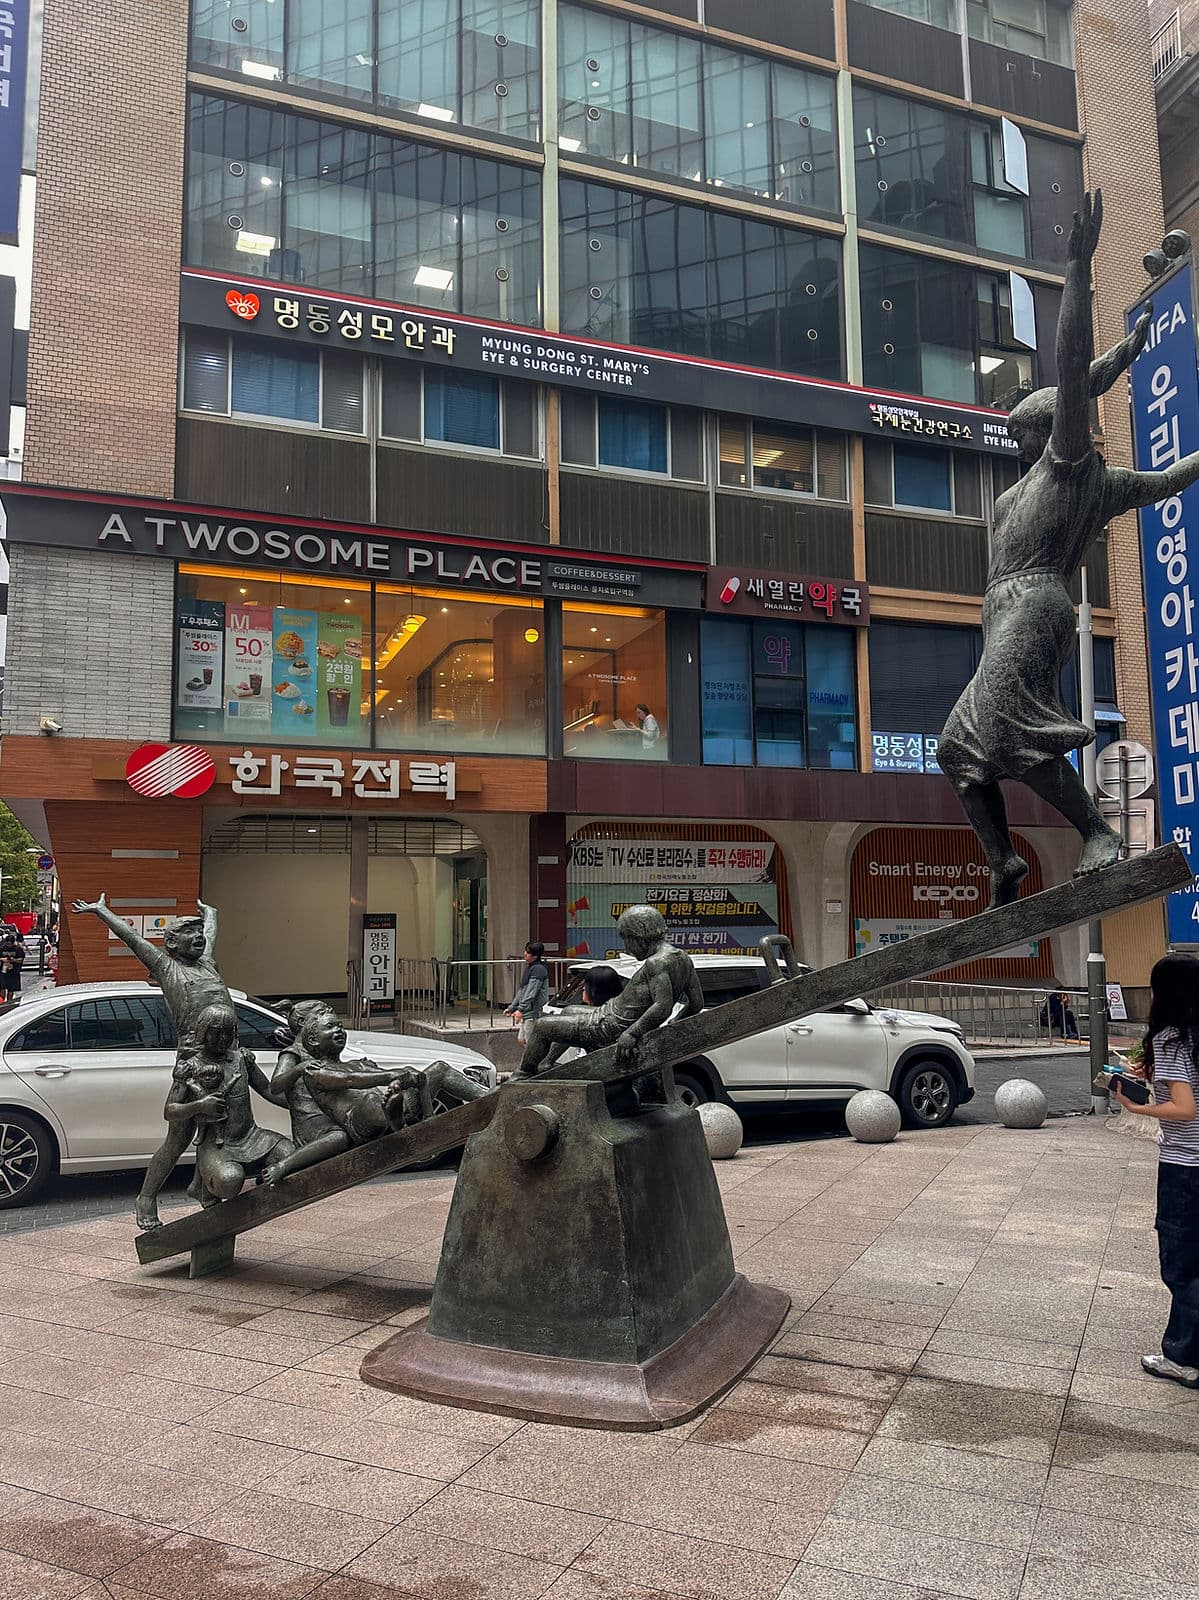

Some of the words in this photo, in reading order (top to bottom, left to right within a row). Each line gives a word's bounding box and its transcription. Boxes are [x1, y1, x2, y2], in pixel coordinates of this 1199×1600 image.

[273, 297, 457, 355] 명동성모안과
[481, 336, 532, 354] MYUNG
[537, 345, 575, 362] DONG
[580, 354, 599, 366] ST.
[603, 358, 650, 375] MARY'S
[481, 350, 505, 364] EYE
[509, 355, 519, 366] &
[523, 358, 582, 377] SURGERY
[586, 369, 633, 386] CENTER
[871, 410, 974, 439] 국제눈건강연구소
[984, 435, 1000, 446] EYE
[98, 513, 132, 543] A
[144, 516, 390, 571] TWOSOME
[407, 546, 542, 586] PLACE
[553, 566, 636, 582] COFFEE&DESSERT
[764, 602, 802, 612] PHARMACY
[764, 635, 792, 673] 약
[809, 691, 849, 705] PHARMACY
[872, 735, 938, 758] 명동성모
[875, 758, 888, 768] Eye
[889, 758, 894, 767] &
[229, 750, 456, 800] 한국전력
[573, 846, 603, 867] KBS는
[708, 848, 726, 868] 즉각
[869, 861, 911, 876] Smart
[915, 861, 963, 878] Energy
[646, 889, 689, 902] 전기요금
[692, 889, 728, 902] 정상화!
[913, 885, 980, 906] KEPCO
[670, 903, 692, 916] 위한
[695, 903, 760, 916] 첫걸음입니다.
[370, 932, 389, 942] 명동
[370, 942, 389, 951] 성모
[702, 932, 728, 945] 전기!
[369, 954, 390, 997] 안과
